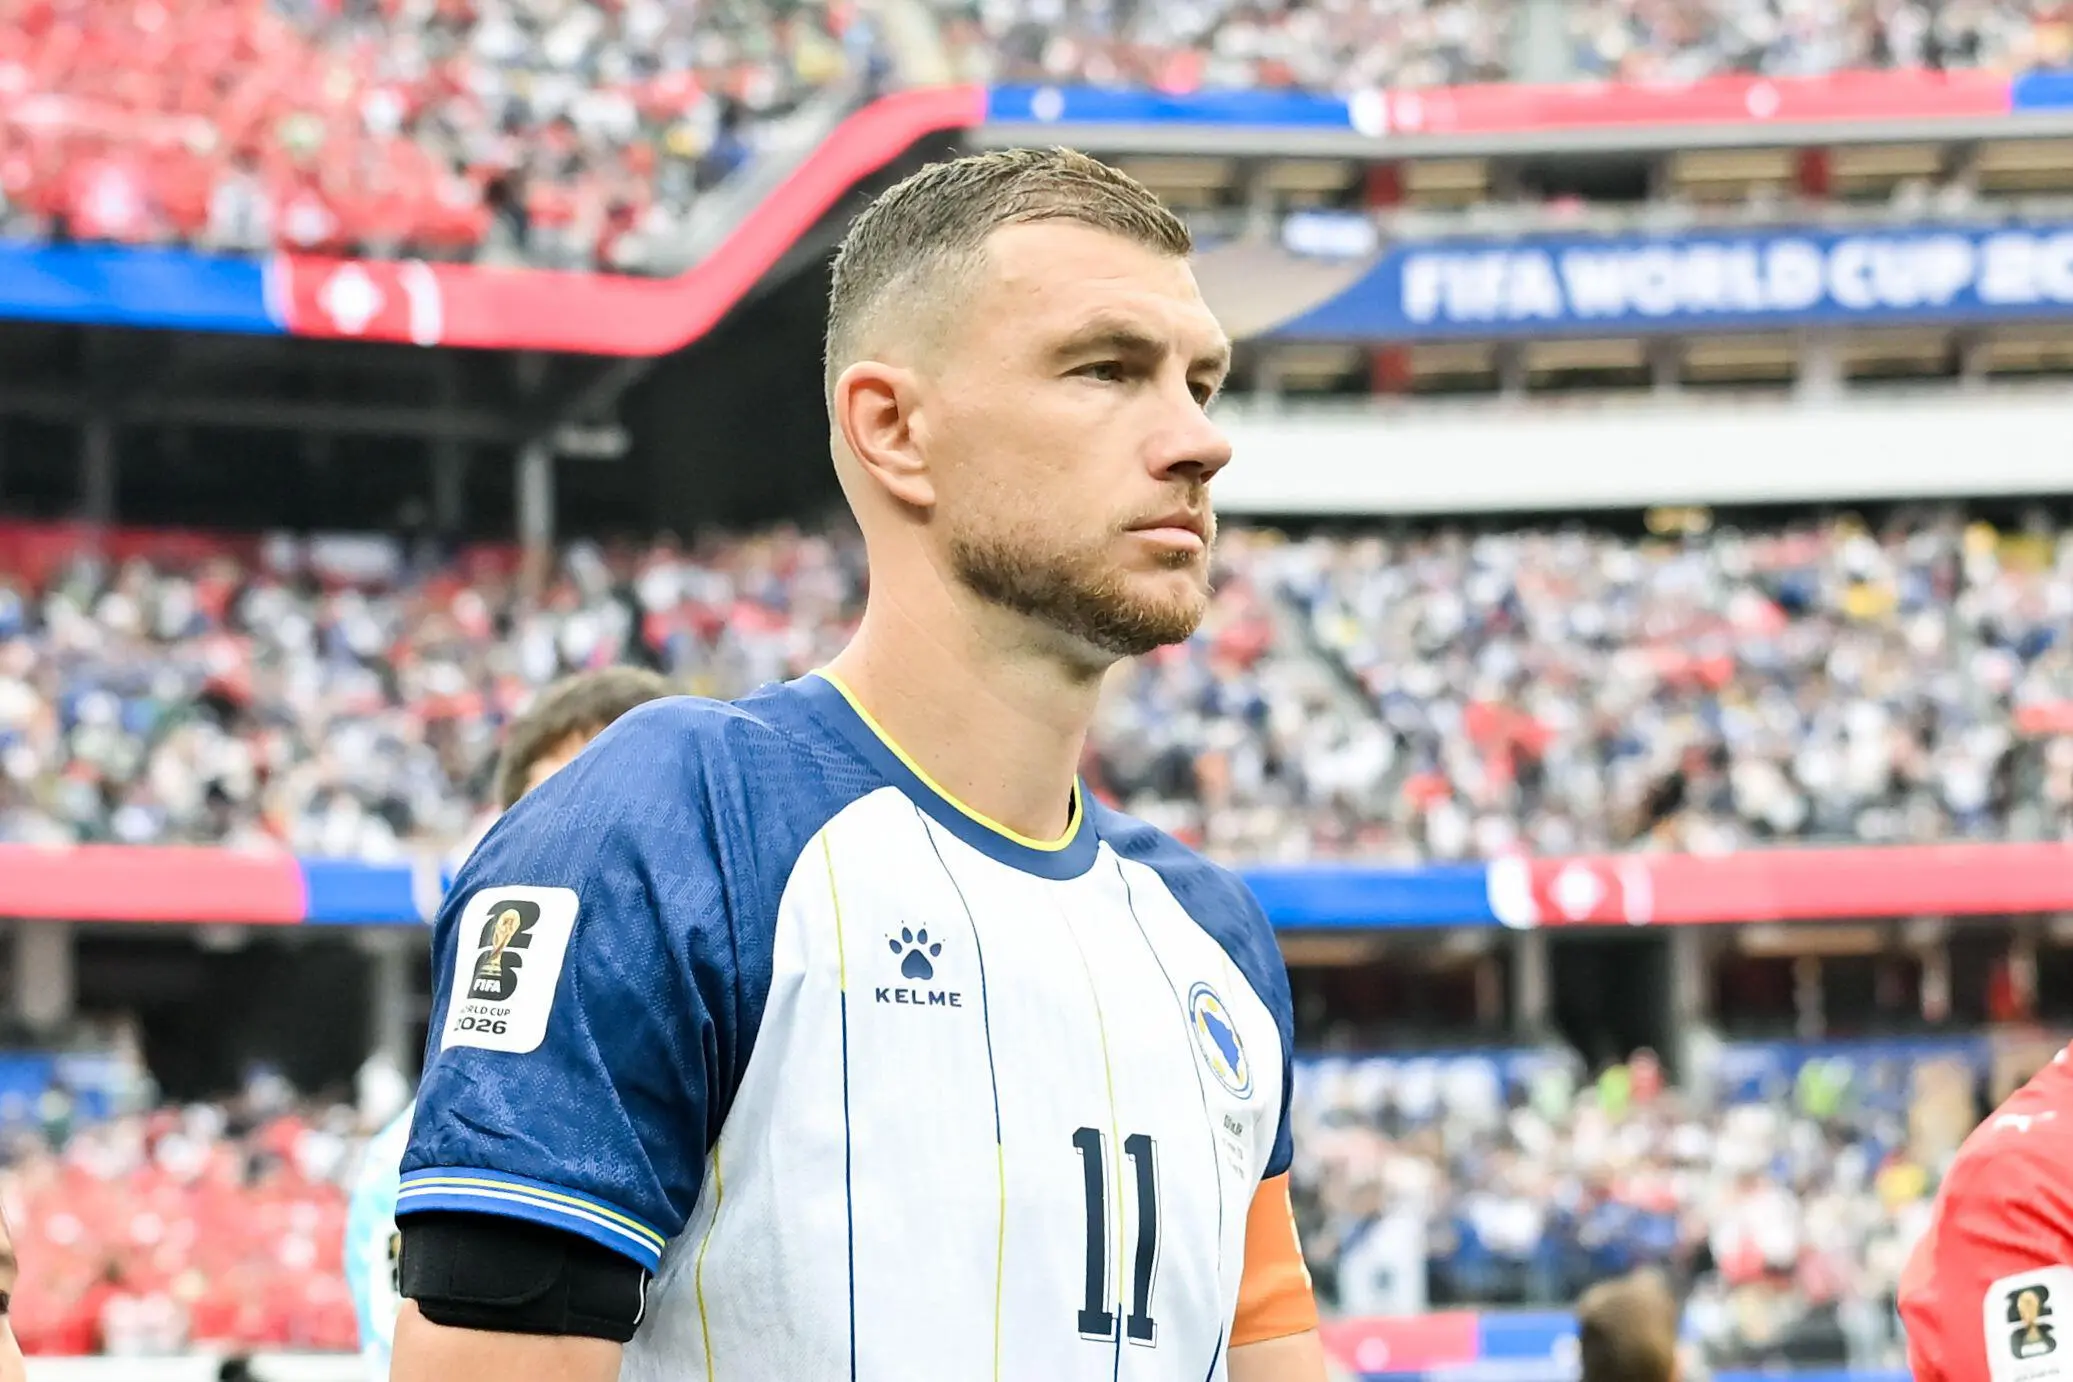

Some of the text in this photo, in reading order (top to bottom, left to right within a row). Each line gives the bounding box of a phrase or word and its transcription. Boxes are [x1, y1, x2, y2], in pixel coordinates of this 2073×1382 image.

[1402, 250, 1562, 322] FIFA
[1561, 238, 1826, 317] WORLD
[1827, 234, 1975, 308] CUP
[472, 978, 502, 993] FIFA
[875, 987, 962, 1008] KELME
[490, 1007, 511, 1017] CUP
[1072, 1126, 1161, 1348] 11
